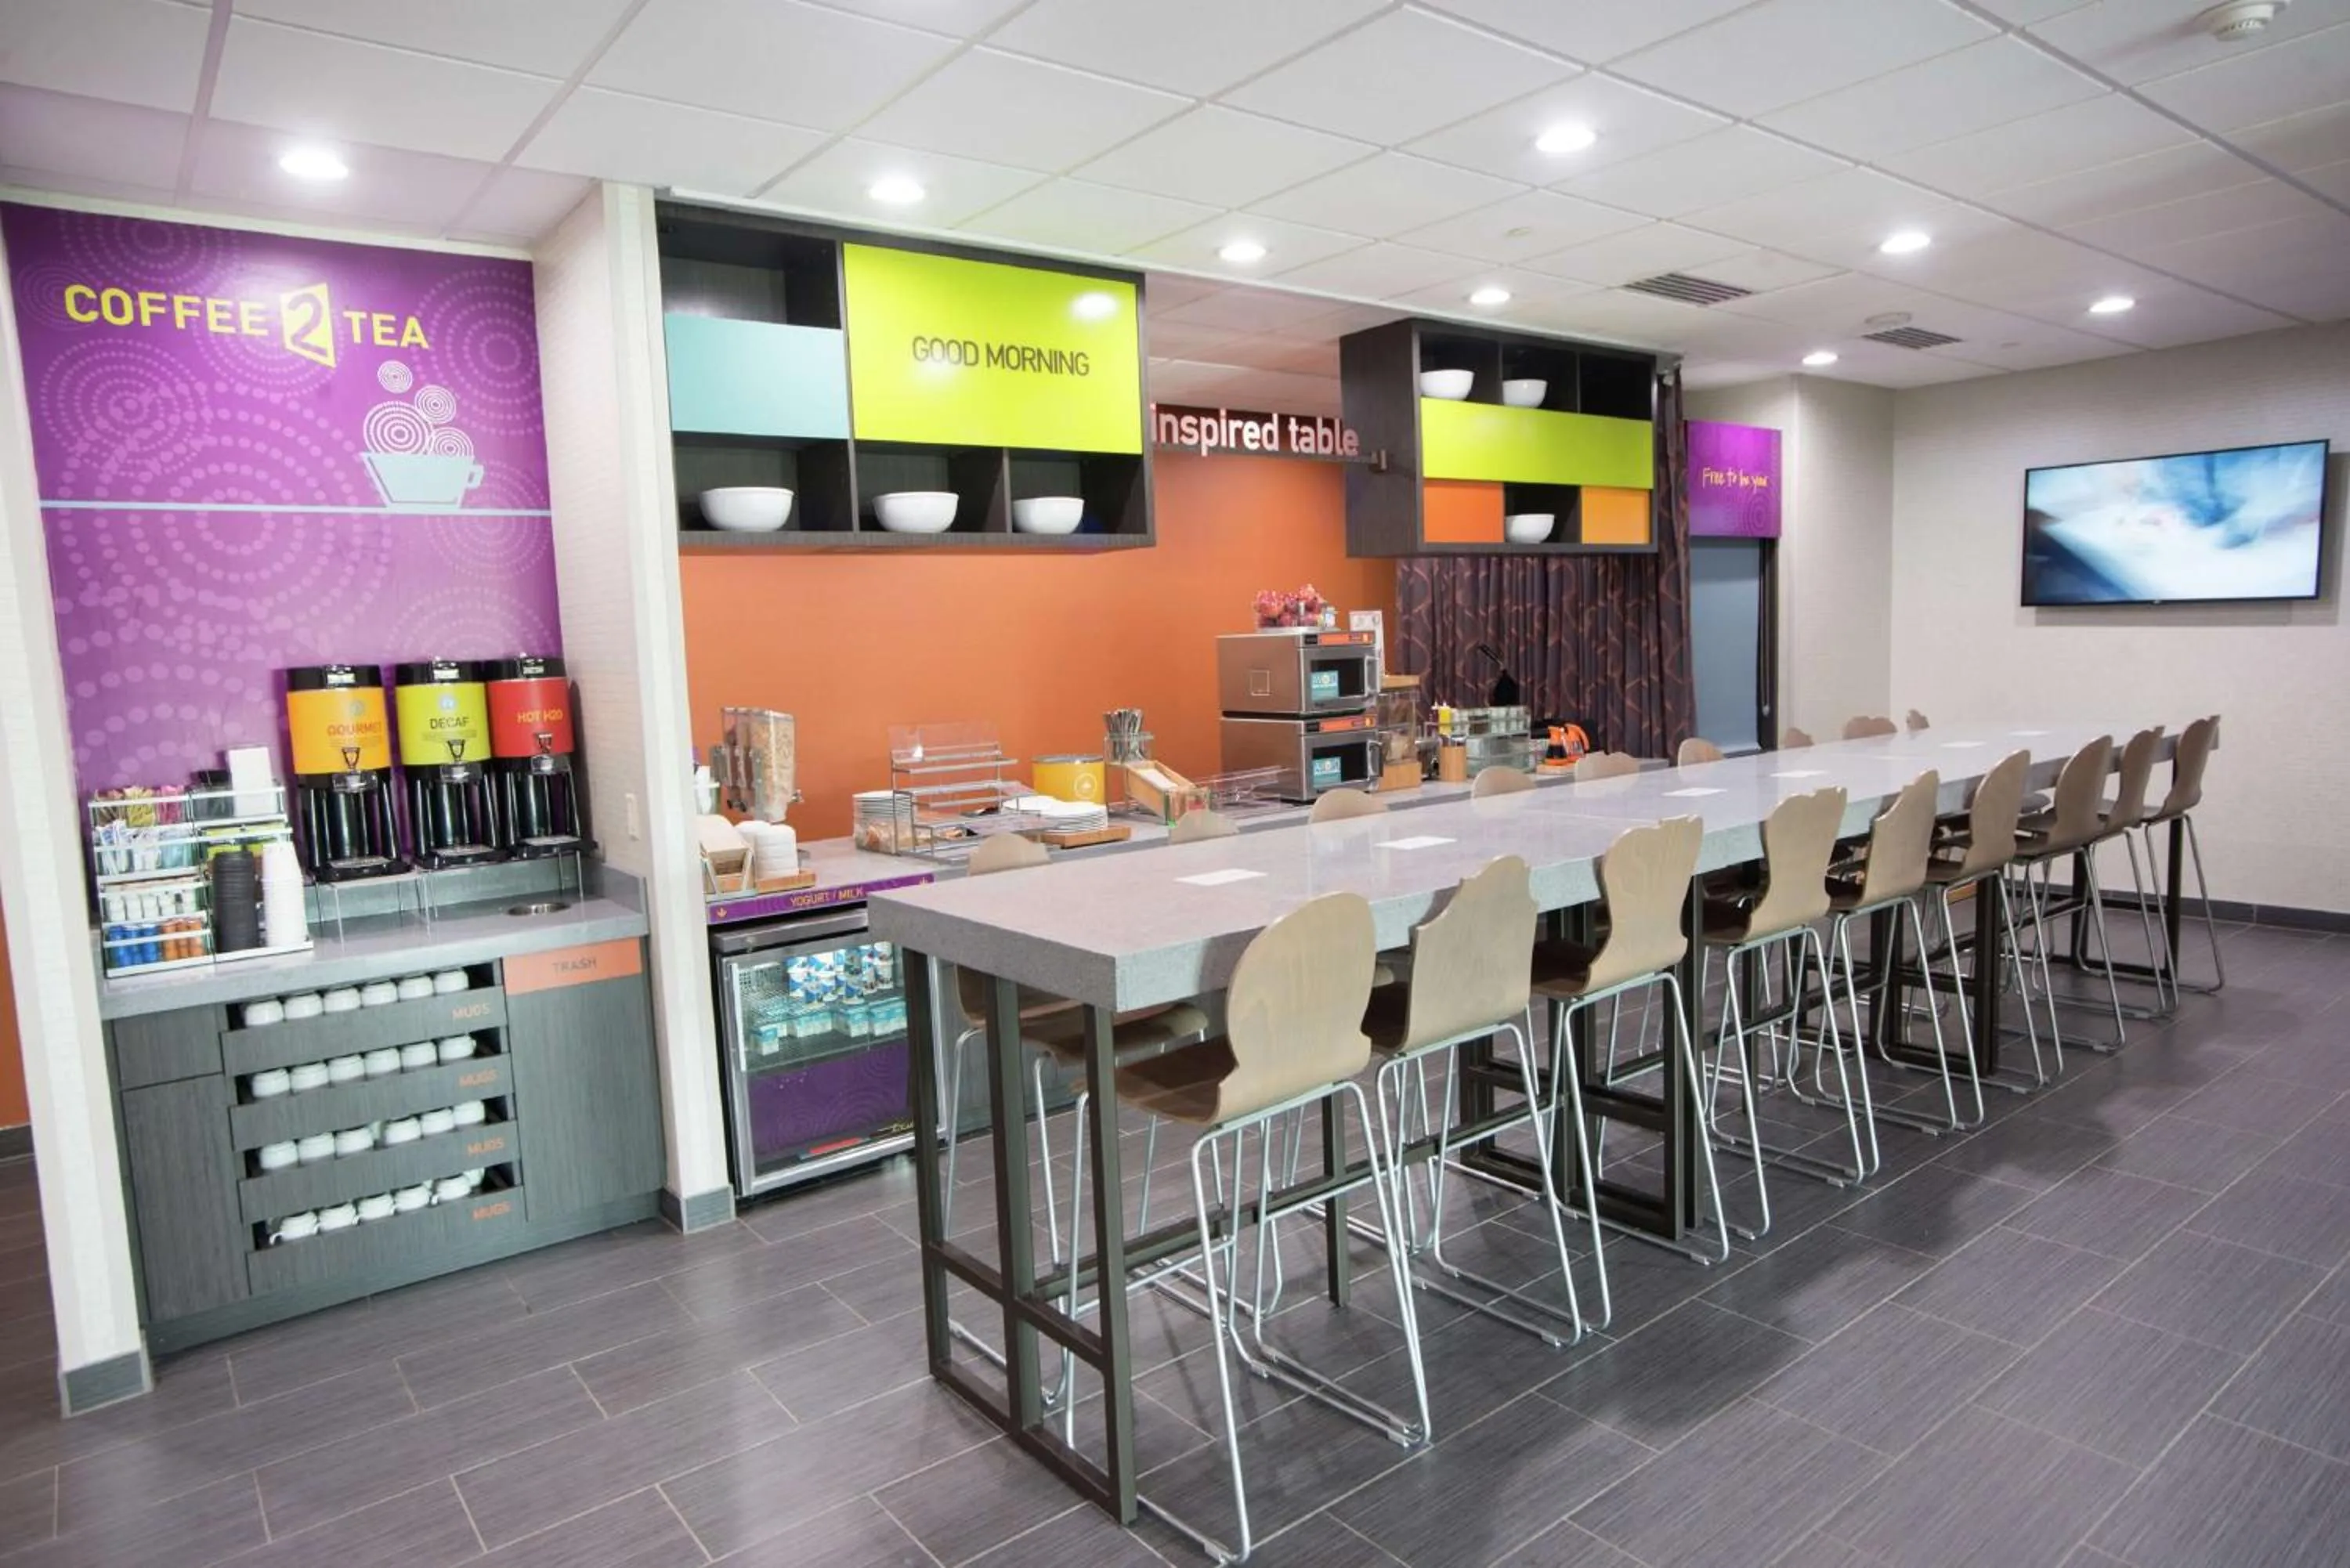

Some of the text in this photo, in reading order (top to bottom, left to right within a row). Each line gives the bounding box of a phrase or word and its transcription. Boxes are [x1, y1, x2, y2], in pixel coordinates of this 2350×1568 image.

[64, 284, 429, 356] COFFEE 2 TEA
[912, 335, 1090, 377] GOOD MORNING
[1150, 401, 1360, 457] inspired table
[1702, 468, 1725, 489] Free
[1726, 467, 1737, 486] to
[428, 717, 469, 729] DECAF
[517, 711, 540, 724] HOT
[790, 892, 829, 908] YOGURT
[838, 886, 864, 900] MILK
[551, 957, 597, 973] TRASH
[452, 1003, 491, 1019] MUGS
